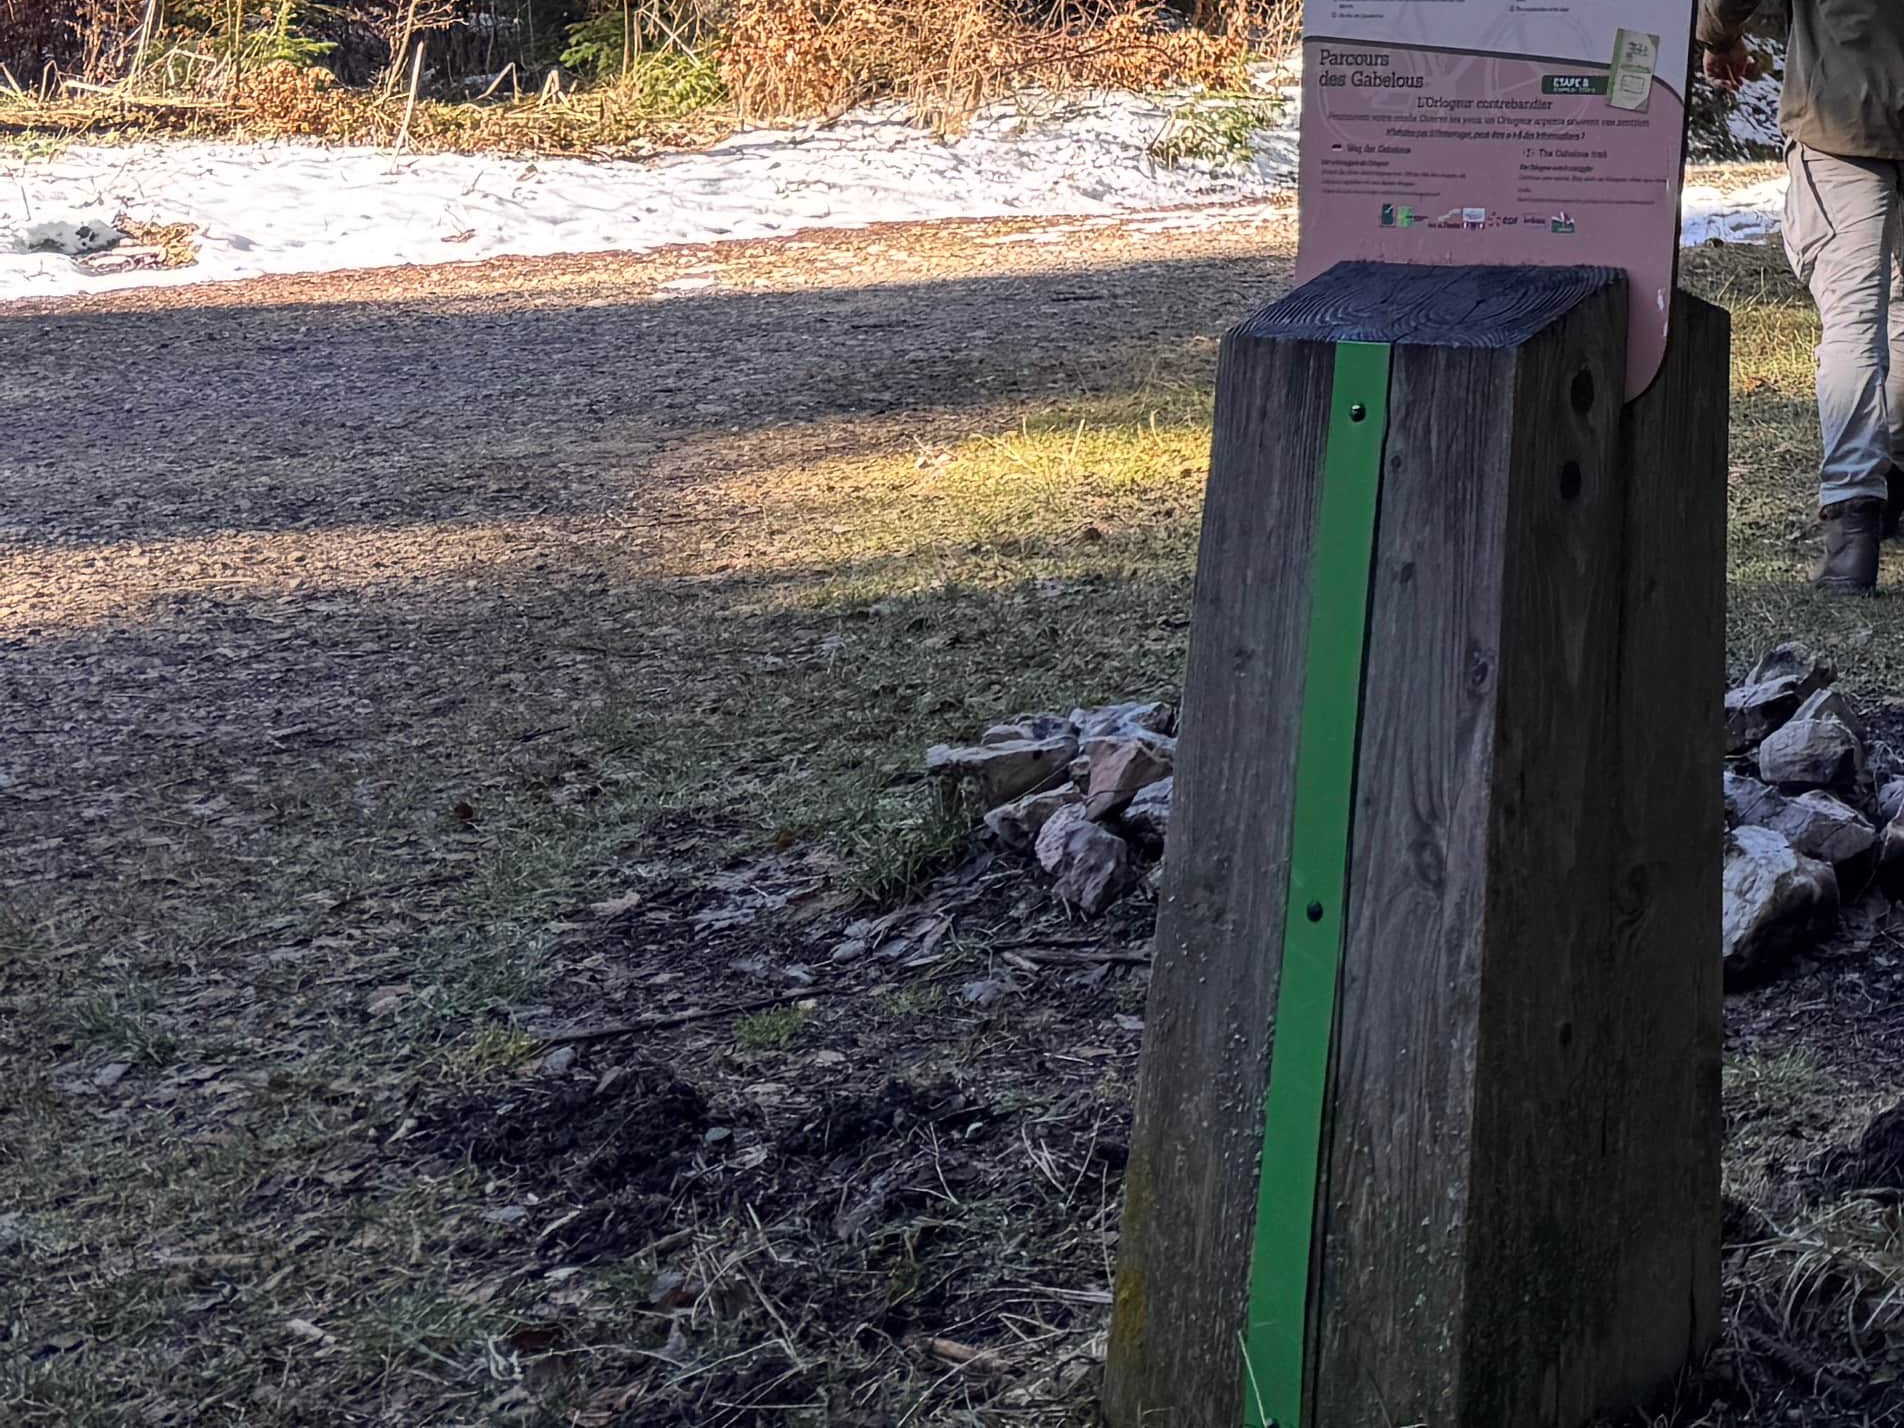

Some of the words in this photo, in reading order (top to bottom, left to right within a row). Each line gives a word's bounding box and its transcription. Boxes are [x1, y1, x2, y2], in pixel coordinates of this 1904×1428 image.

[1320, 49, 1389, 66] Parcours
[1319, 70, 1346, 87] des
[1351, 71, 1424, 88] Gabelous
[1476, 96, 1552, 111] contrebandier
